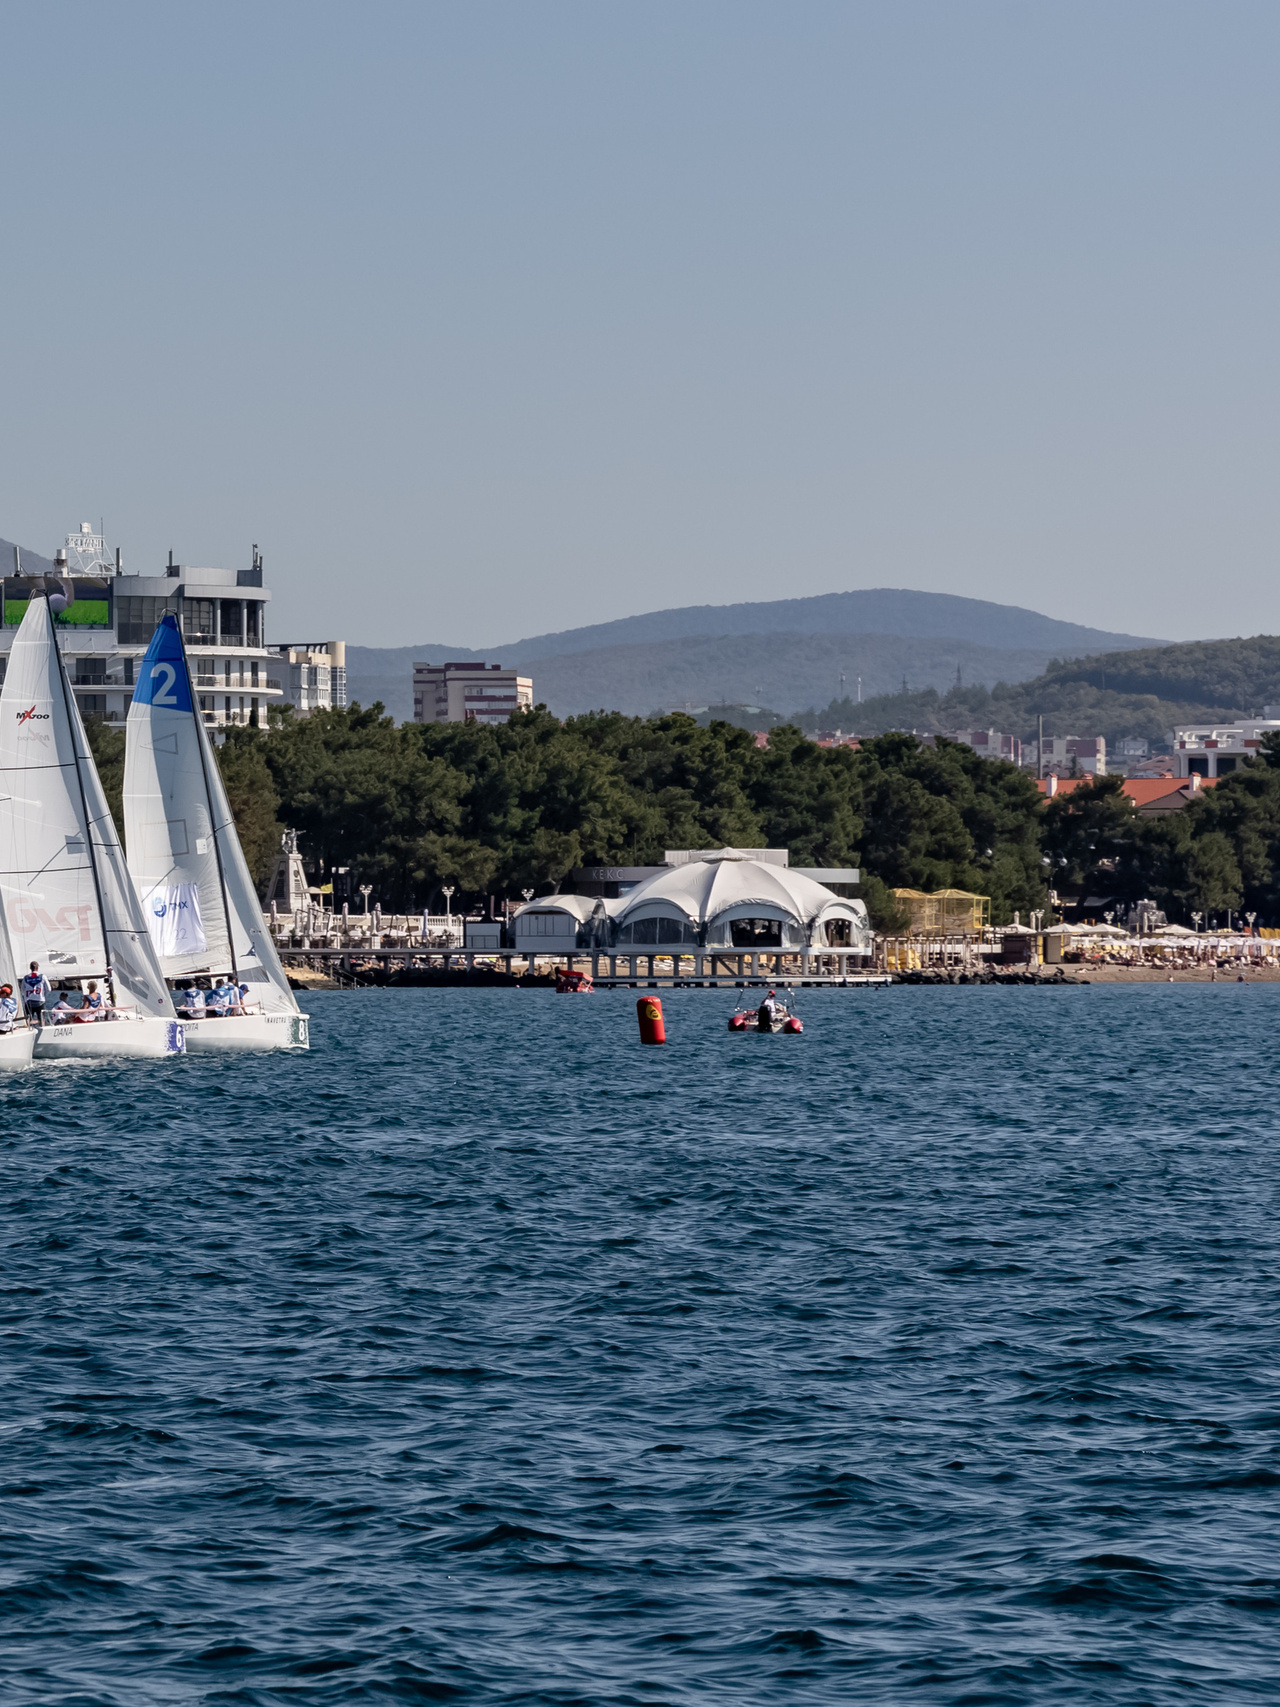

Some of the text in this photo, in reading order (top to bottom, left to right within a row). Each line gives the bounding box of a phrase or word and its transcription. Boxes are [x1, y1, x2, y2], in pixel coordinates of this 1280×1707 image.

[150, 662, 178, 705] 2
[53, 1028, 73, 1037] DANA
[175, 1025, 182, 1048] 6
[298, 1020, 305, 1041] 8
